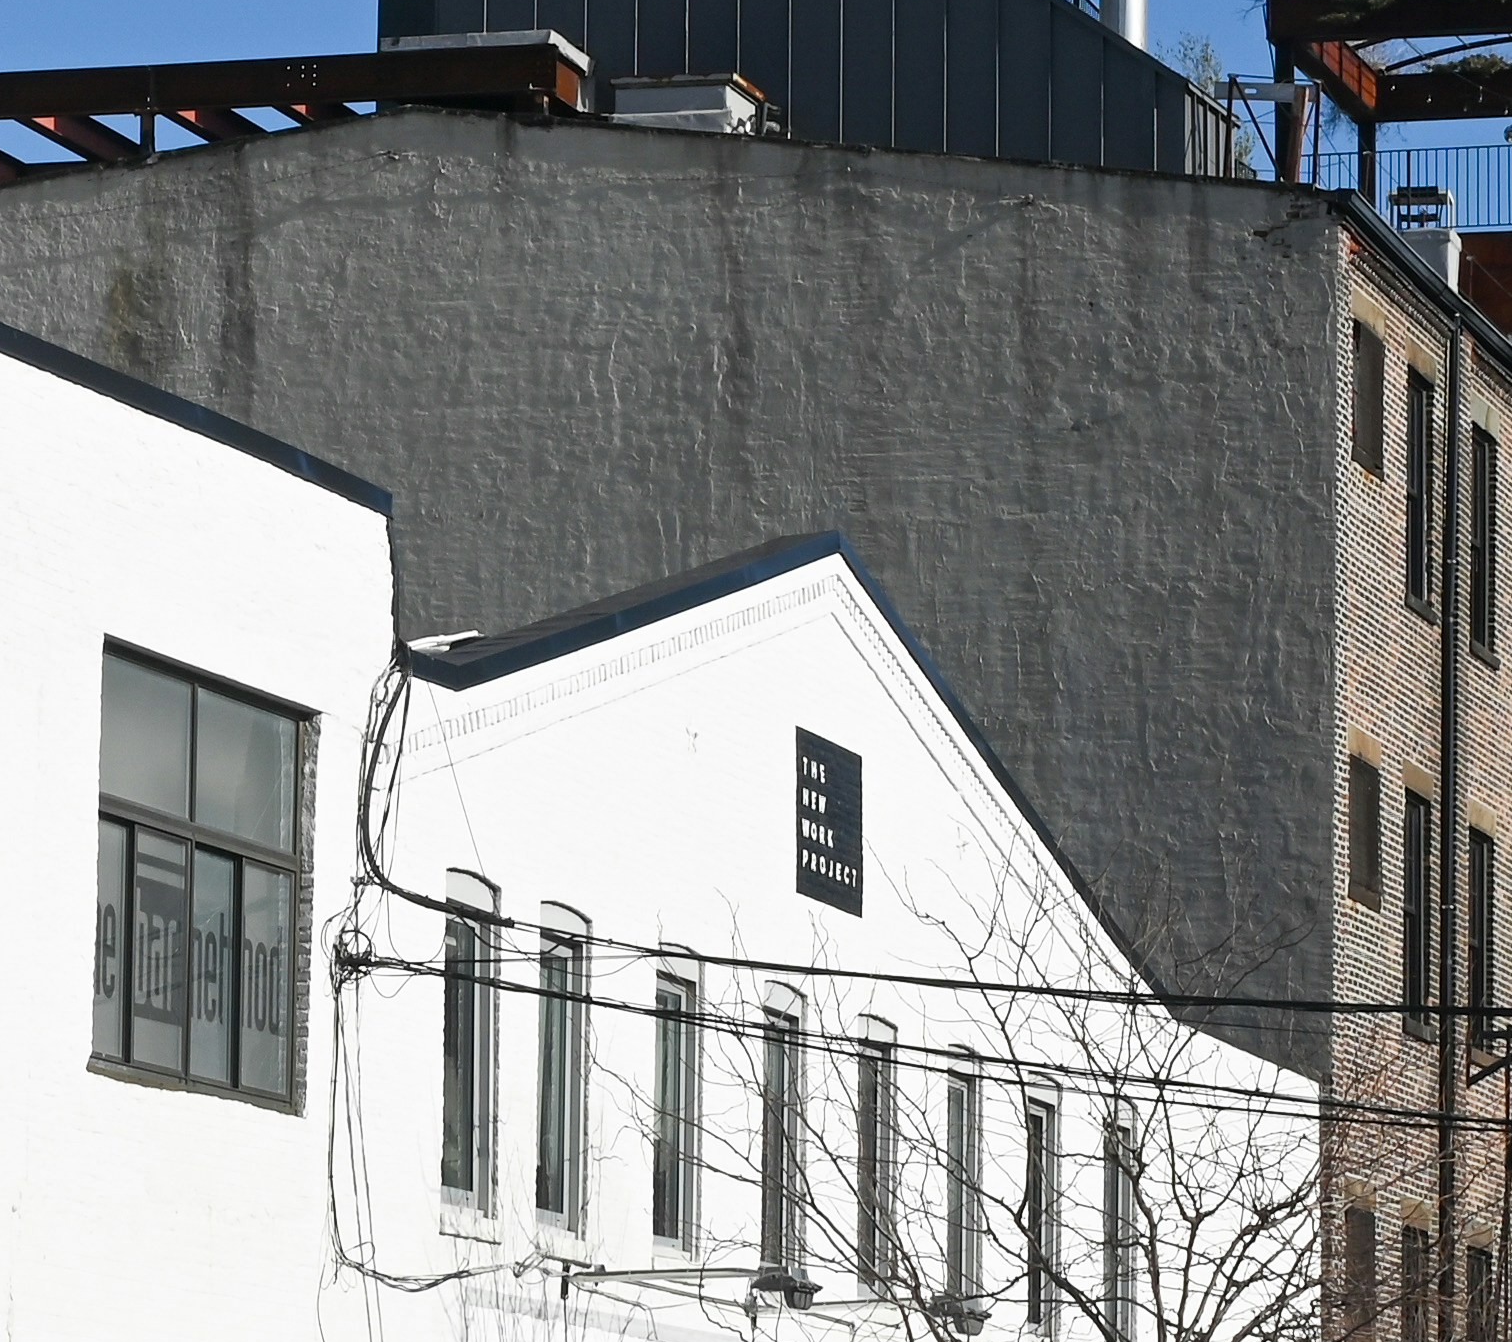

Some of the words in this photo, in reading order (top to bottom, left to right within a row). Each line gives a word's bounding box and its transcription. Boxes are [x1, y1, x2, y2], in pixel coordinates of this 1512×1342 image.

[802, 756, 826, 784] THE
[802, 787, 827, 814] NEW
[801, 817, 834, 848] WORK
[802, 849, 857, 888] PROJECT
